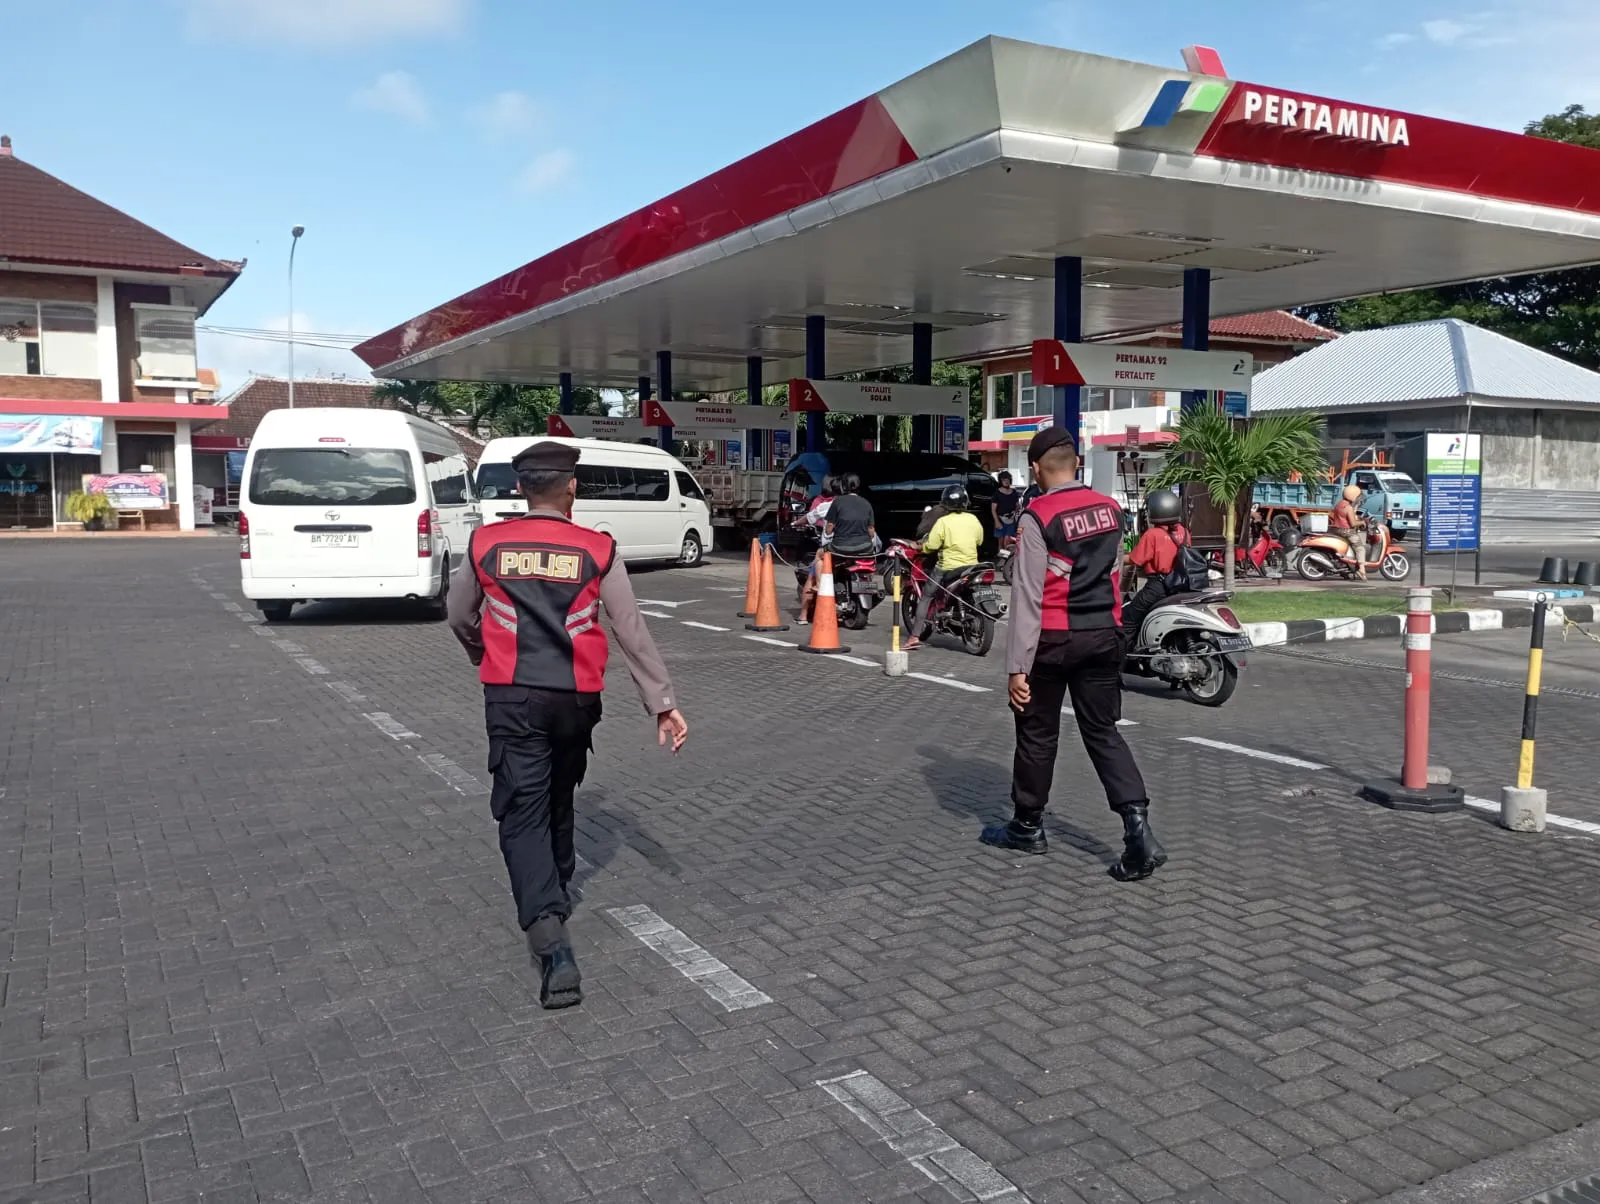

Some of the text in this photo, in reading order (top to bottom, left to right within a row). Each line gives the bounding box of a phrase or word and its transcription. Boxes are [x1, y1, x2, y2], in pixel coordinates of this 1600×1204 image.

[1244, 91, 1410, 146] PERTAMINA
[1052, 354, 1060, 371] 1
[1115, 353, 1168, 366] PERTAMAX 92
[1114, 370, 1156, 381] PERTALITE
[804, 389, 813, 402] 2
[860, 385, 892, 394] PERTALITE
[653, 408, 661, 418] 3
[555, 421, 562, 430] 4
[1063, 507, 1116, 539] POLISI
[500, 551, 580, 579] POLISI
